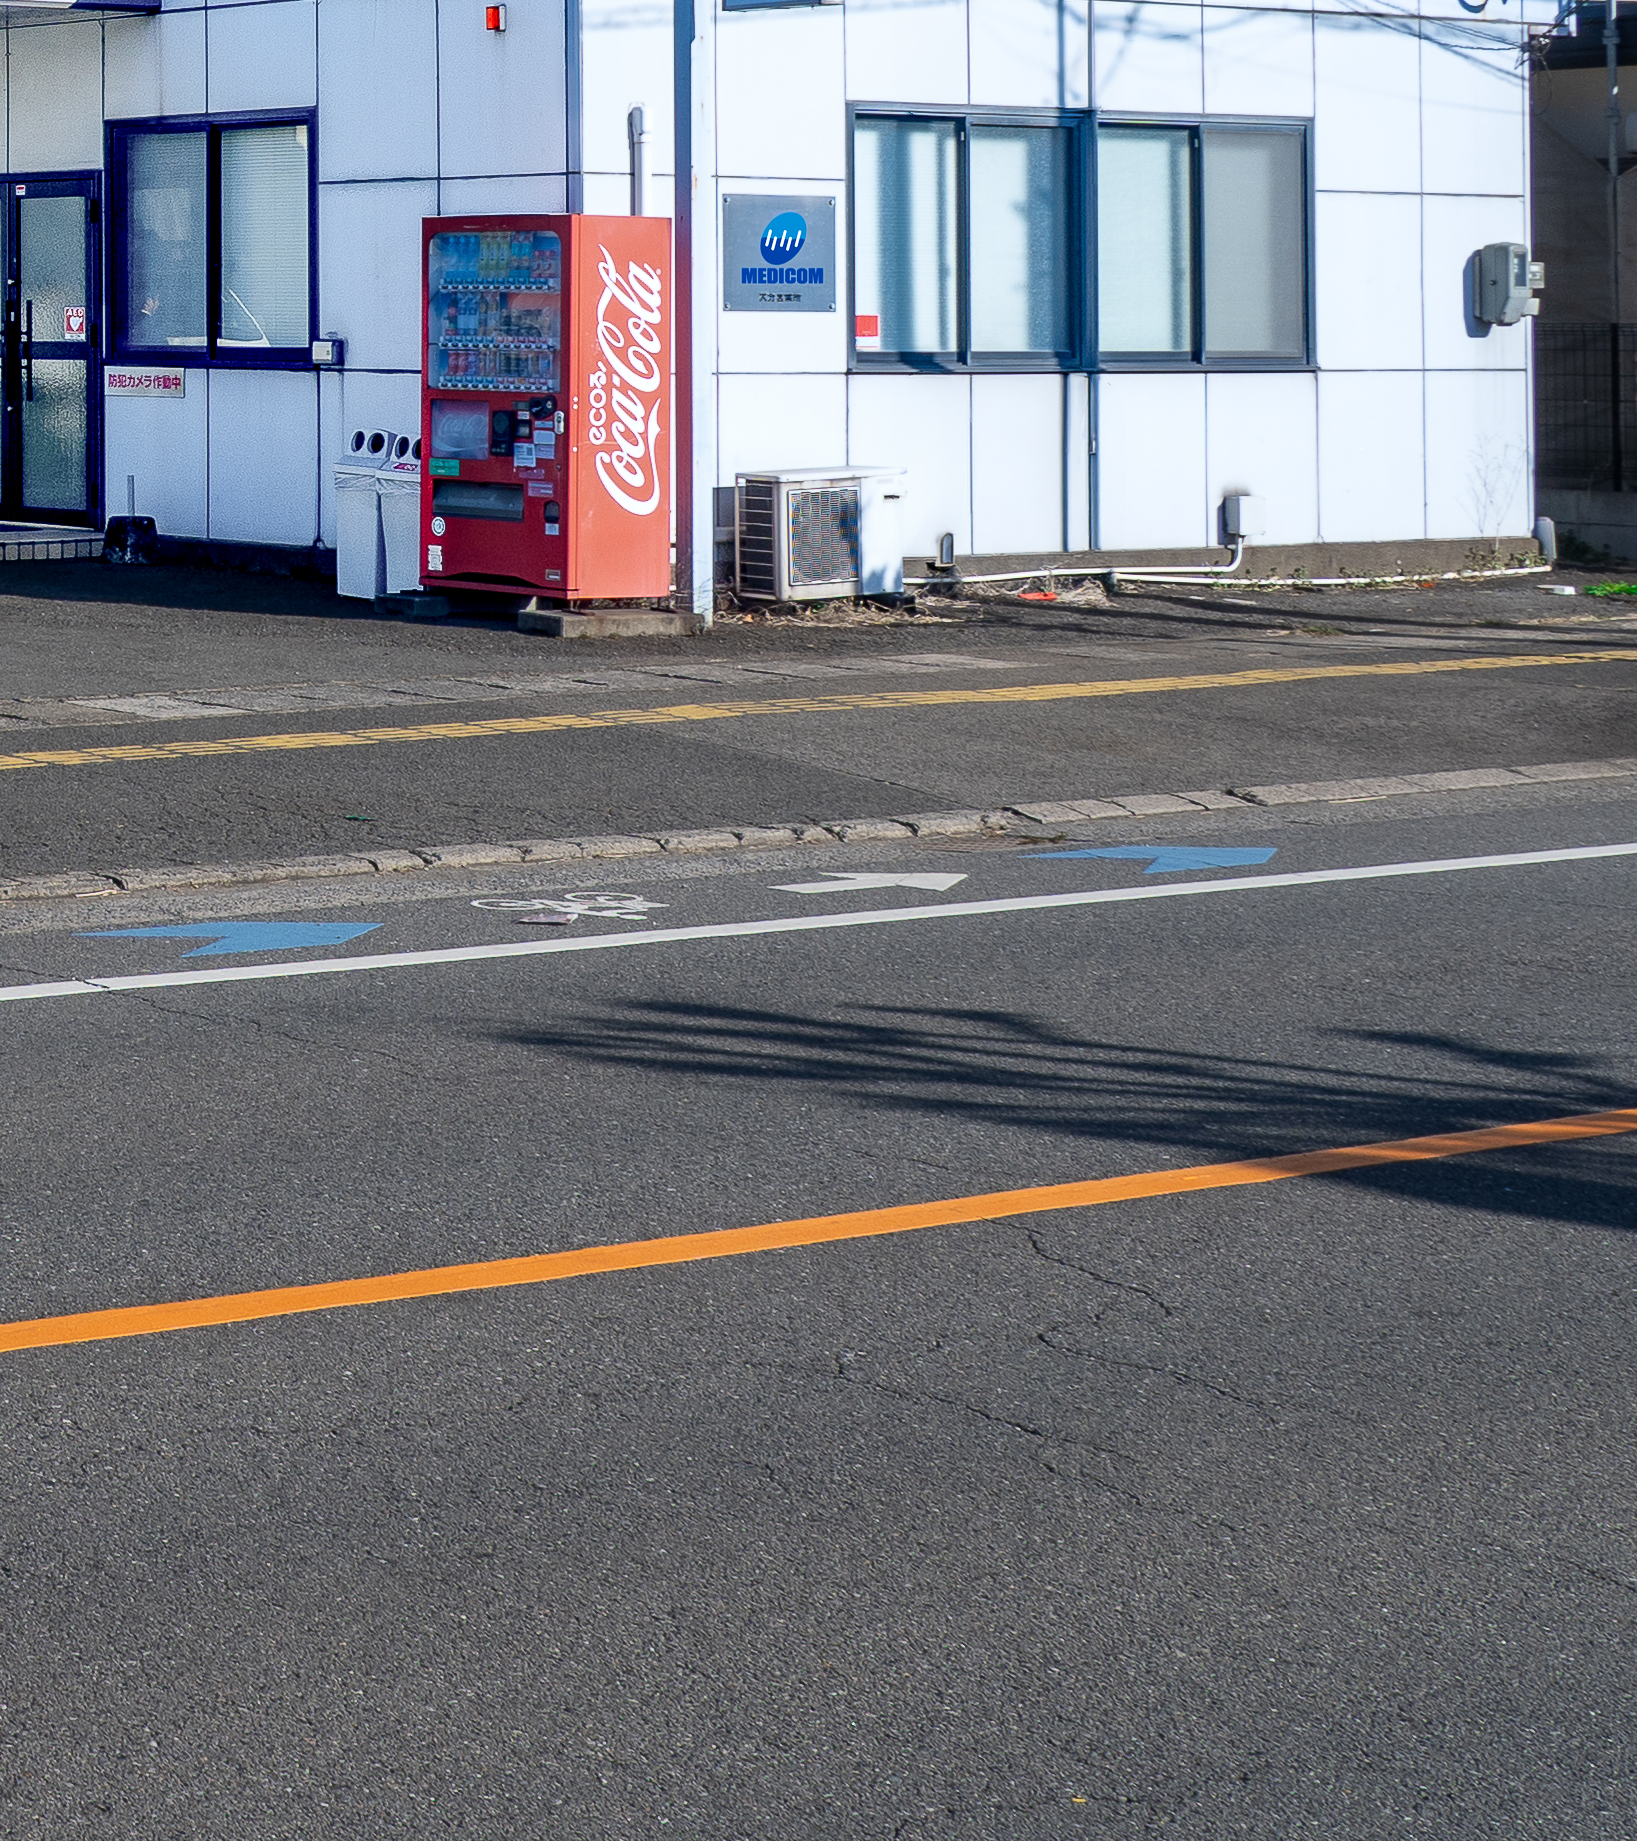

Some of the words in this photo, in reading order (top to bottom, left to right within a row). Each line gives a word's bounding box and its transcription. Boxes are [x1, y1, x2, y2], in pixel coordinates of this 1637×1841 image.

[741, 267, 824, 284] MEDICOM
[108, 373, 182, 390] 防犯カメラ作動中
[595, 243, 662, 516] Coca-Cola
